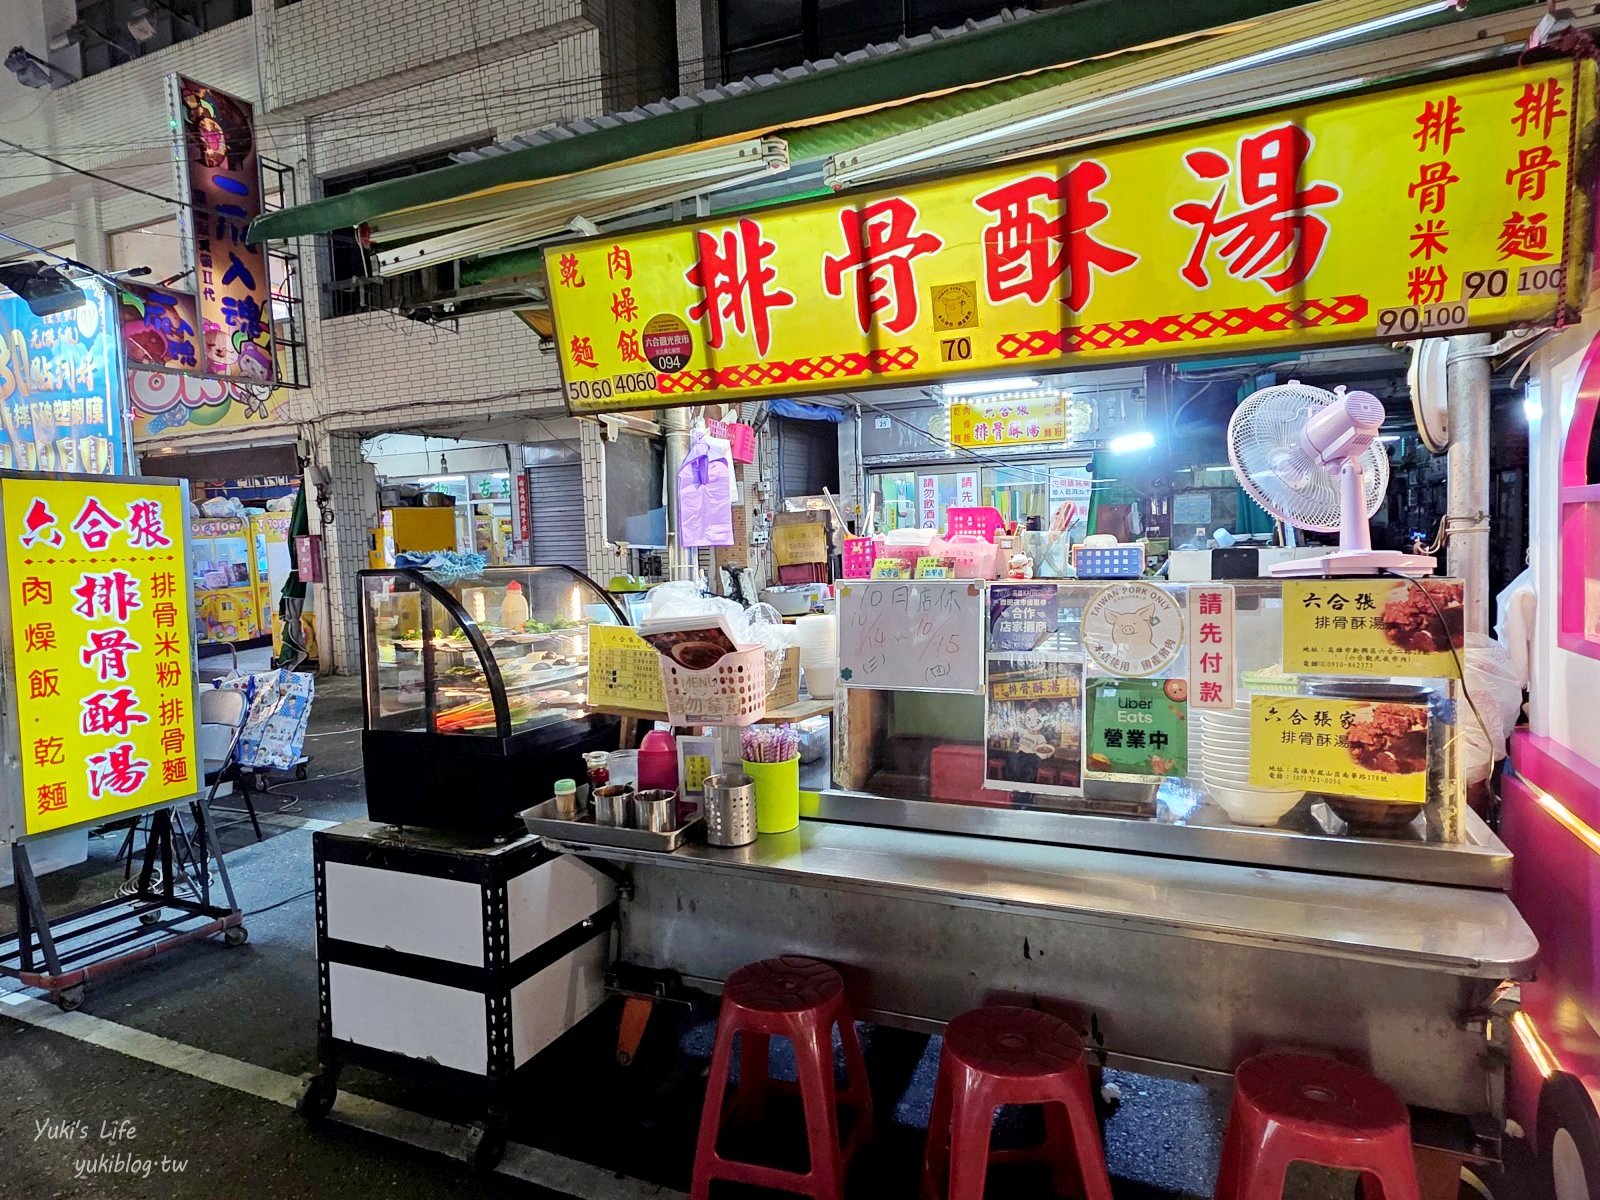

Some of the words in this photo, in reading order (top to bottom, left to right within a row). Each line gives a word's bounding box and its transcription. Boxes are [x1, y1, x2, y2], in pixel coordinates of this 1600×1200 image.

[1497, 77, 1568, 262] 排骨麵
[1408, 95, 1466, 306] 排骨米粉
[685, 121, 1340, 358] 排骨酥湯
[1465, 270, 1508, 300] 90
[1518, 267, 1562, 292] 100
[559, 253, 599, 369] 乾麵
[607, 245, 647, 363] 肉燥飯
[1379, 309, 1419, 335] 90
[1422, 305, 1466, 328] 100
[658, 355, 681, 370] 094
[943, 337, 971, 361] 70
[923, 478, 935, 519] 請勿飲酒
[21, 497, 173, 550] 六合張
[1012, 607, 1036, 619] 合作
[1091, 589, 1120, 617] TAIWAN
[1122, 586, 1148, 596] PORK
[1149, 592, 1172, 611] ONLY
[1302, 592, 1377, 611] 六合張
[1314, 615, 1386, 630] 排骨酥湯
[1198, 592, 1223, 704] 請先付款
[72, 570, 149, 799] 排骨酥湯
[681, 676, 717, 688] MENU
[1117, 710, 1153, 723] Eats
[1118, 697, 1153, 710] Uber
[1264, 706, 1357, 729] 六合張家
[1104, 727, 1169, 750] 營業中
[1281, 730, 1350, 749] 排骨酥湯
